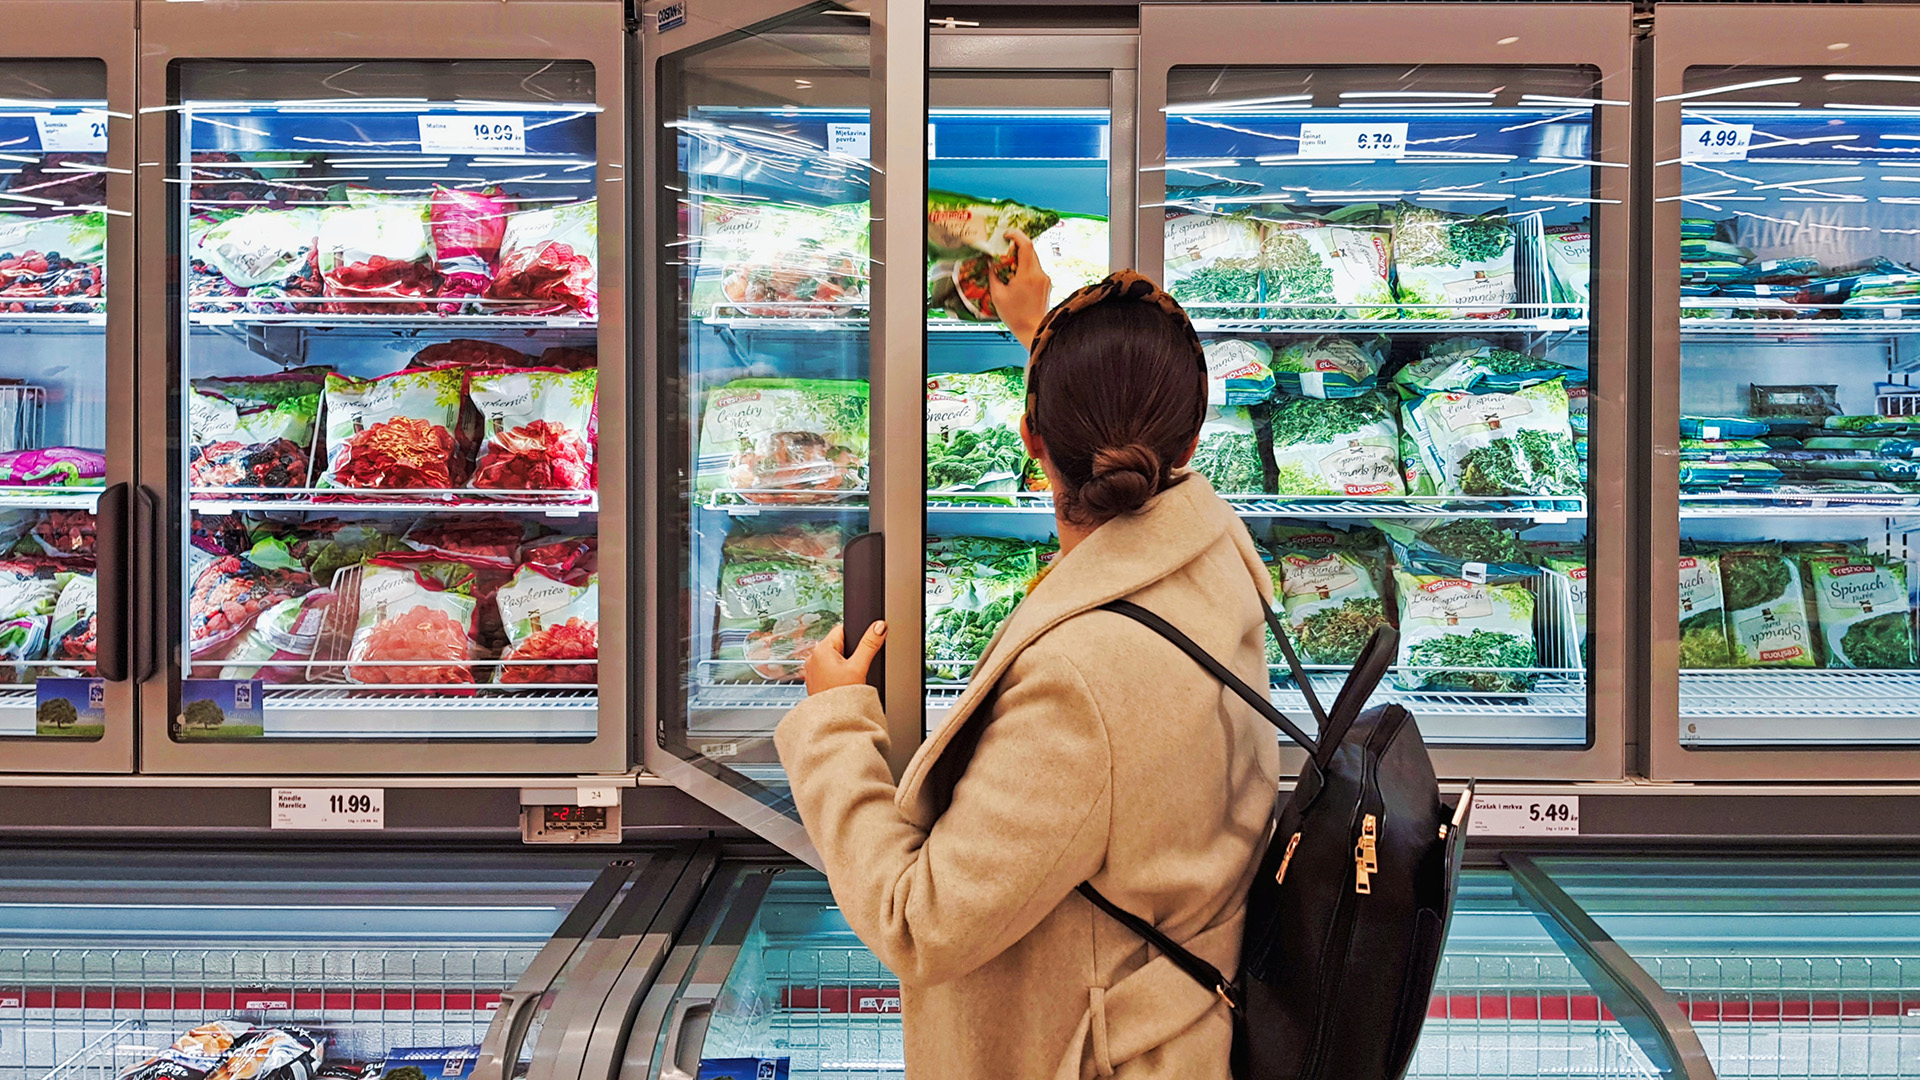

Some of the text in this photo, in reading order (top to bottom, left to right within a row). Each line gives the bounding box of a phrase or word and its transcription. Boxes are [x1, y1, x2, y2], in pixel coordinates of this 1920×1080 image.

[1699, 130, 1737, 146] 4.99
[1179, 216, 1220, 235] spinach
[1545, 225, 1577, 234] reshona
[717, 405, 762, 424] Country
[1292, 535, 1333, 543] Freshona
[1833, 566, 1872, 575] Freshona
[1678, 570, 1705, 590] nach
[1830, 574, 1886, 600] Spinach
[503, 586, 566, 608] Raspberries
[1441, 590, 1486, 605] spinach
[1749, 624, 1802, 649] Spinach
[1763, 646, 1800, 659] Freshona
[330, 795, 371, 813] 11.99
[1529, 803, 1569, 822] 5.49
